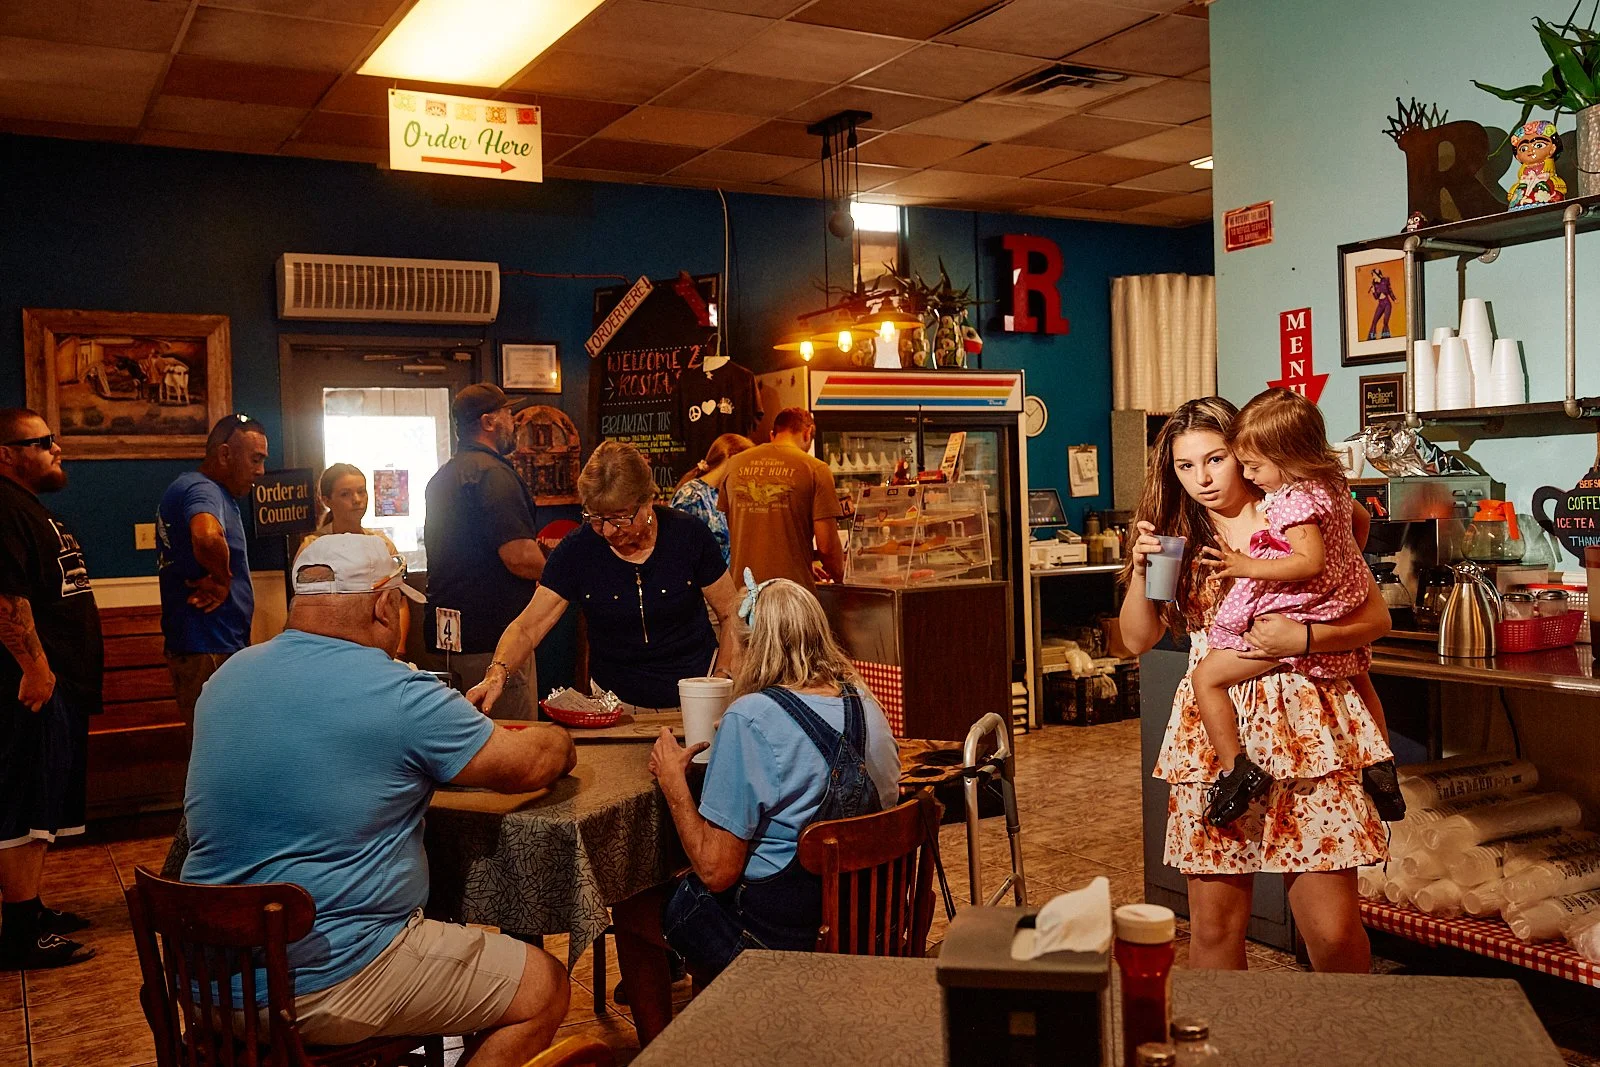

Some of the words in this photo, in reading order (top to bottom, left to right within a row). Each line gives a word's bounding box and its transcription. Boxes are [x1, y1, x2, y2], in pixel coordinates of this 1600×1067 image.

[403, 120, 471, 151] Order
[478, 128, 533, 156] Here
[1003, 232, 1070, 335] R
[591, 308, 625, 349] ORDER
[619, 282, 647, 316] HERE
[607, 350, 681, 371] WELCOME
[601, 412, 654, 434] BREAKFAST
[738, 466, 765, 476] SNIPE
[768, 467, 796, 477] HUNT
[256, 482, 294, 504] Order
[296, 482, 309, 498] at
[1567, 496, 1600, 511] COFFE
[258, 503, 309, 525] Counter
[1556, 517, 1573, 529] ICE
[1573, 517, 1595, 529] TEA
[443, 619, 452, 641] 4
